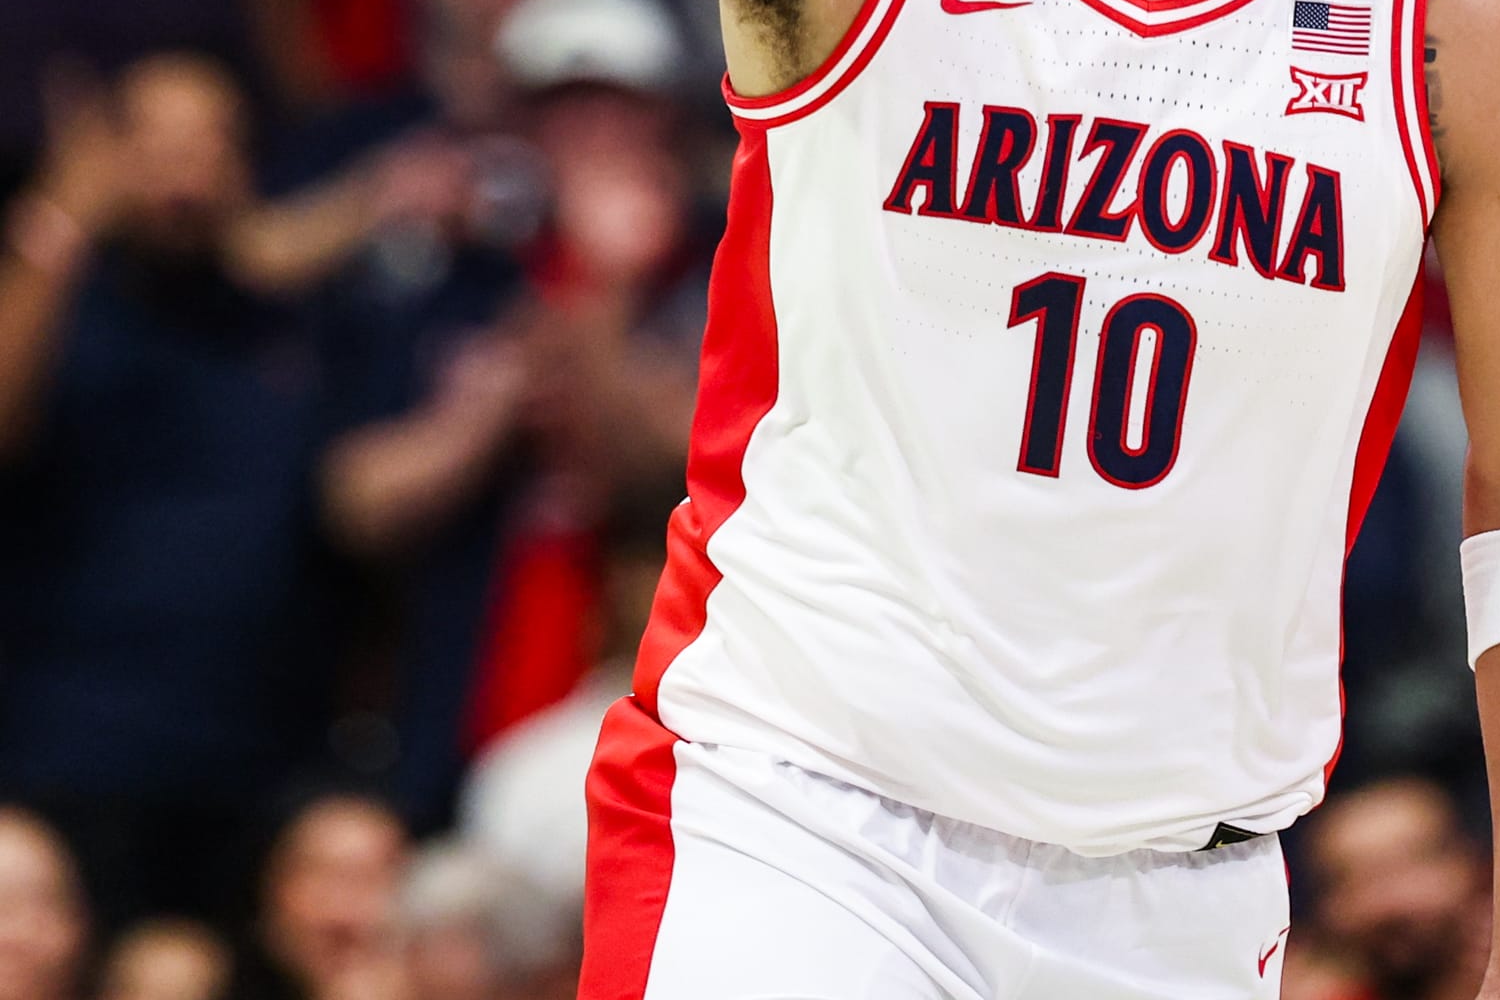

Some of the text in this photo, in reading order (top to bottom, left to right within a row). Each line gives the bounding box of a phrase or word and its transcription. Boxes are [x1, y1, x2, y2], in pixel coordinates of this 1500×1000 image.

[1290, 70, 1363, 115] XII
[883, 101, 1345, 292] ARIZONA
[1007, 272, 1197, 490] 10
